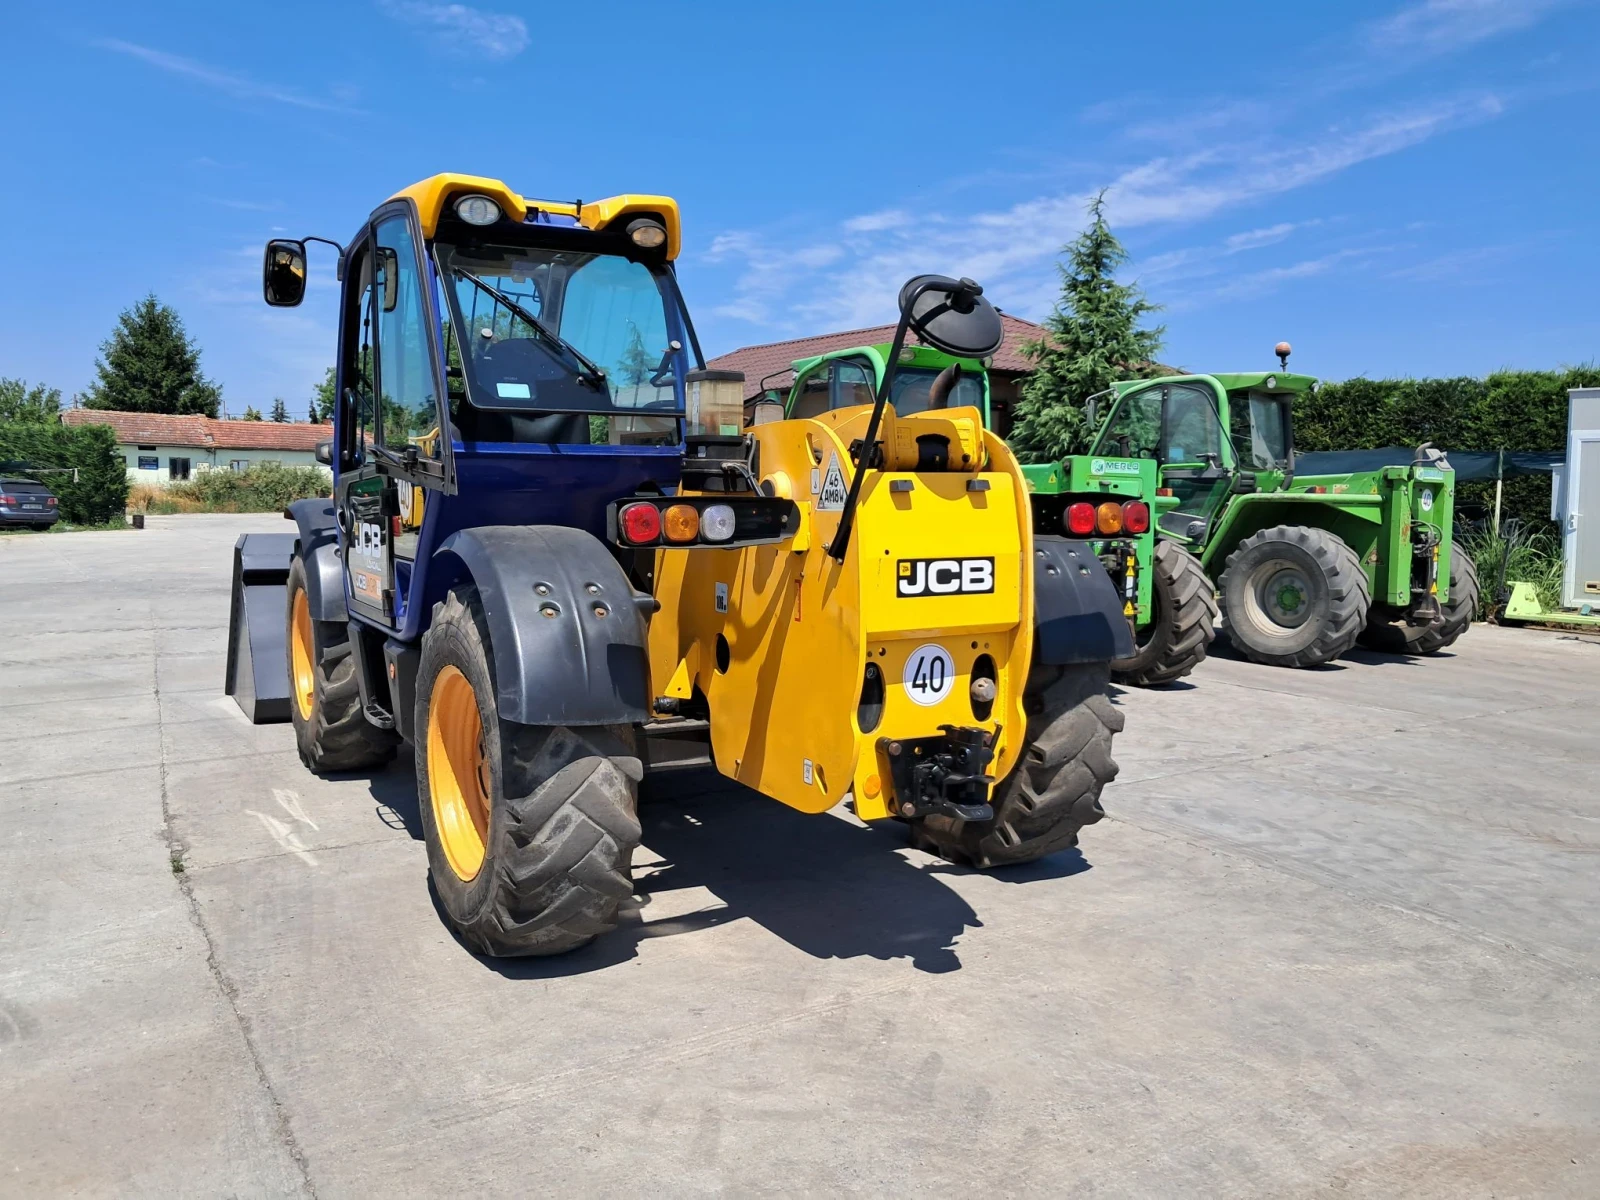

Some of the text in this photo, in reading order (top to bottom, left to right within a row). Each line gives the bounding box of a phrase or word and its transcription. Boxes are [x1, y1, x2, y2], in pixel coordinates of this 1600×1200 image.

[829, 473, 839, 488] 46
[1423, 493, 1431, 506] 40
[355, 522, 381, 558] JCB
[899, 559, 993, 594] JCB
[911, 655, 945, 694] 40
